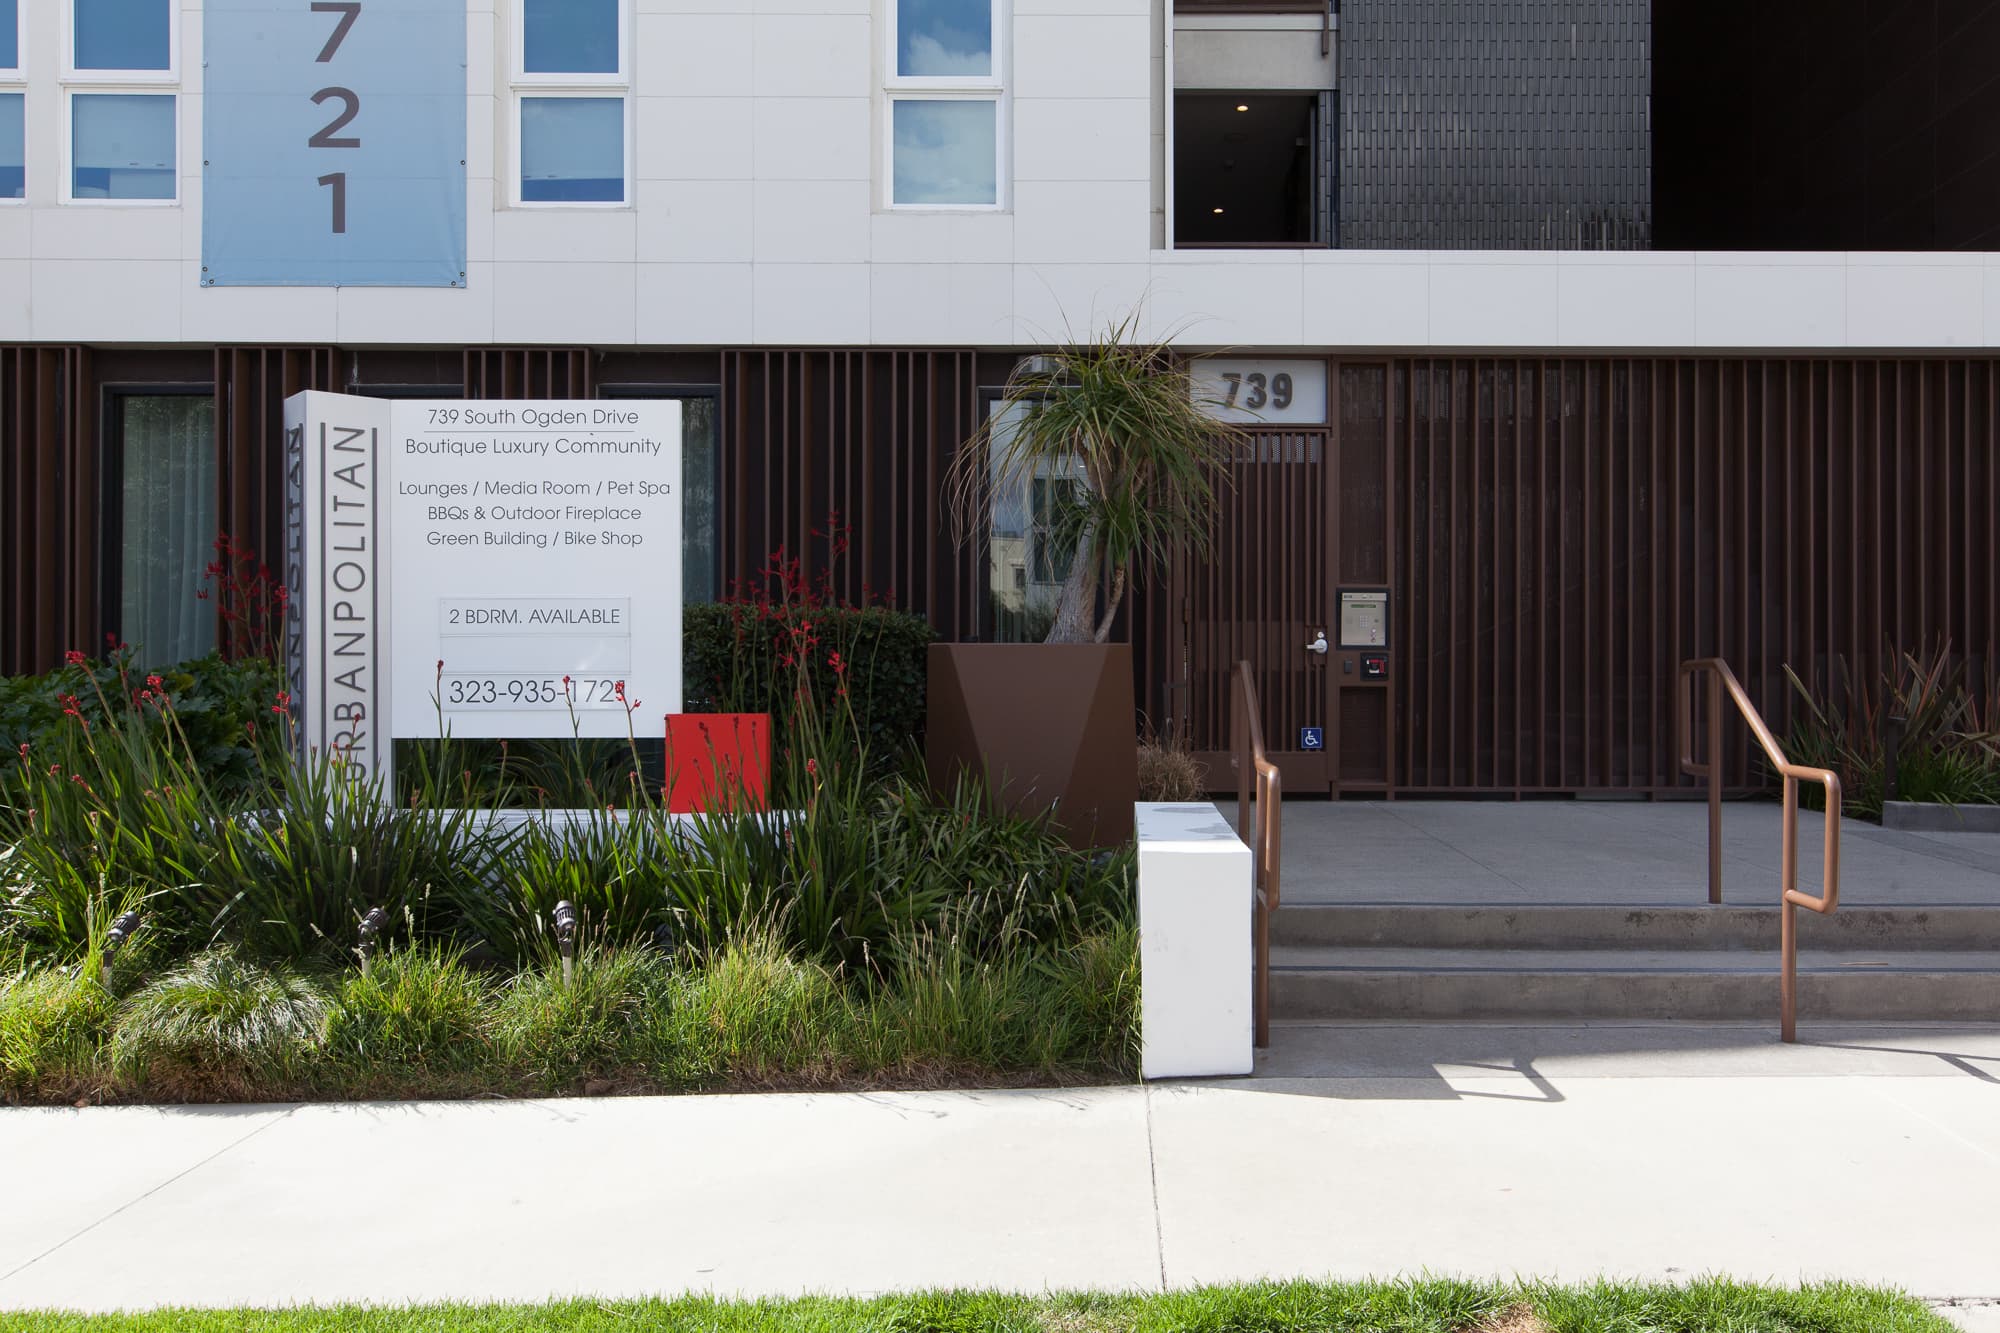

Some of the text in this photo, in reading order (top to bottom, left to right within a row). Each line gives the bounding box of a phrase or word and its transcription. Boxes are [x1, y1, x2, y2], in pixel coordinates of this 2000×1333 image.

[1222, 372, 1293, 409] 739
[428, 409, 639, 428] 739 South Ogden Drive
[405, 438, 662, 457] Boutique Luxury Community
[399, 480, 671, 498] Lounges / Media Room / Pet Spa
[428, 505, 642, 523] BBQs & Outdoor Fireplace
[426, 530, 643, 549] Green Building / Bike Shop
[449, 608, 621, 625] 2 BDRM. AVAILABLE
